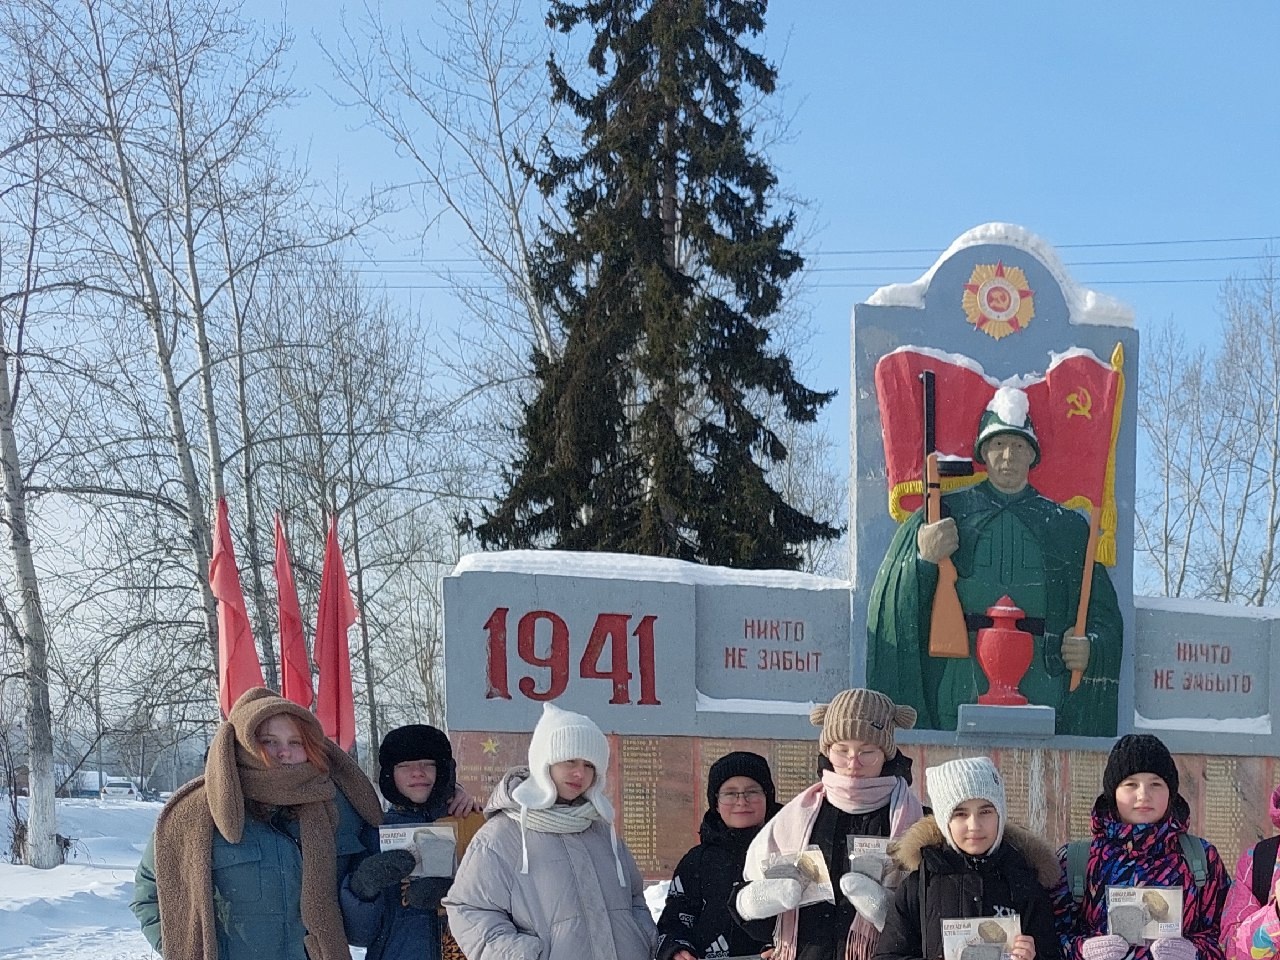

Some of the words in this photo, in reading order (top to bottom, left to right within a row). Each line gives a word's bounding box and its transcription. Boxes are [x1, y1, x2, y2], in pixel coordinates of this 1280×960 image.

[744, 618, 805, 642] НИКТО
[483, 607, 661, 705] 1941
[725, 647, 748, 670] НЕ
[757, 649, 822, 673] ЗАБЫТ
[1177, 642, 1231, 664] НИЧТО
[1154, 668, 1175, 690] НЕ
[1182, 670, 1252, 694] ЗАБЫТО
